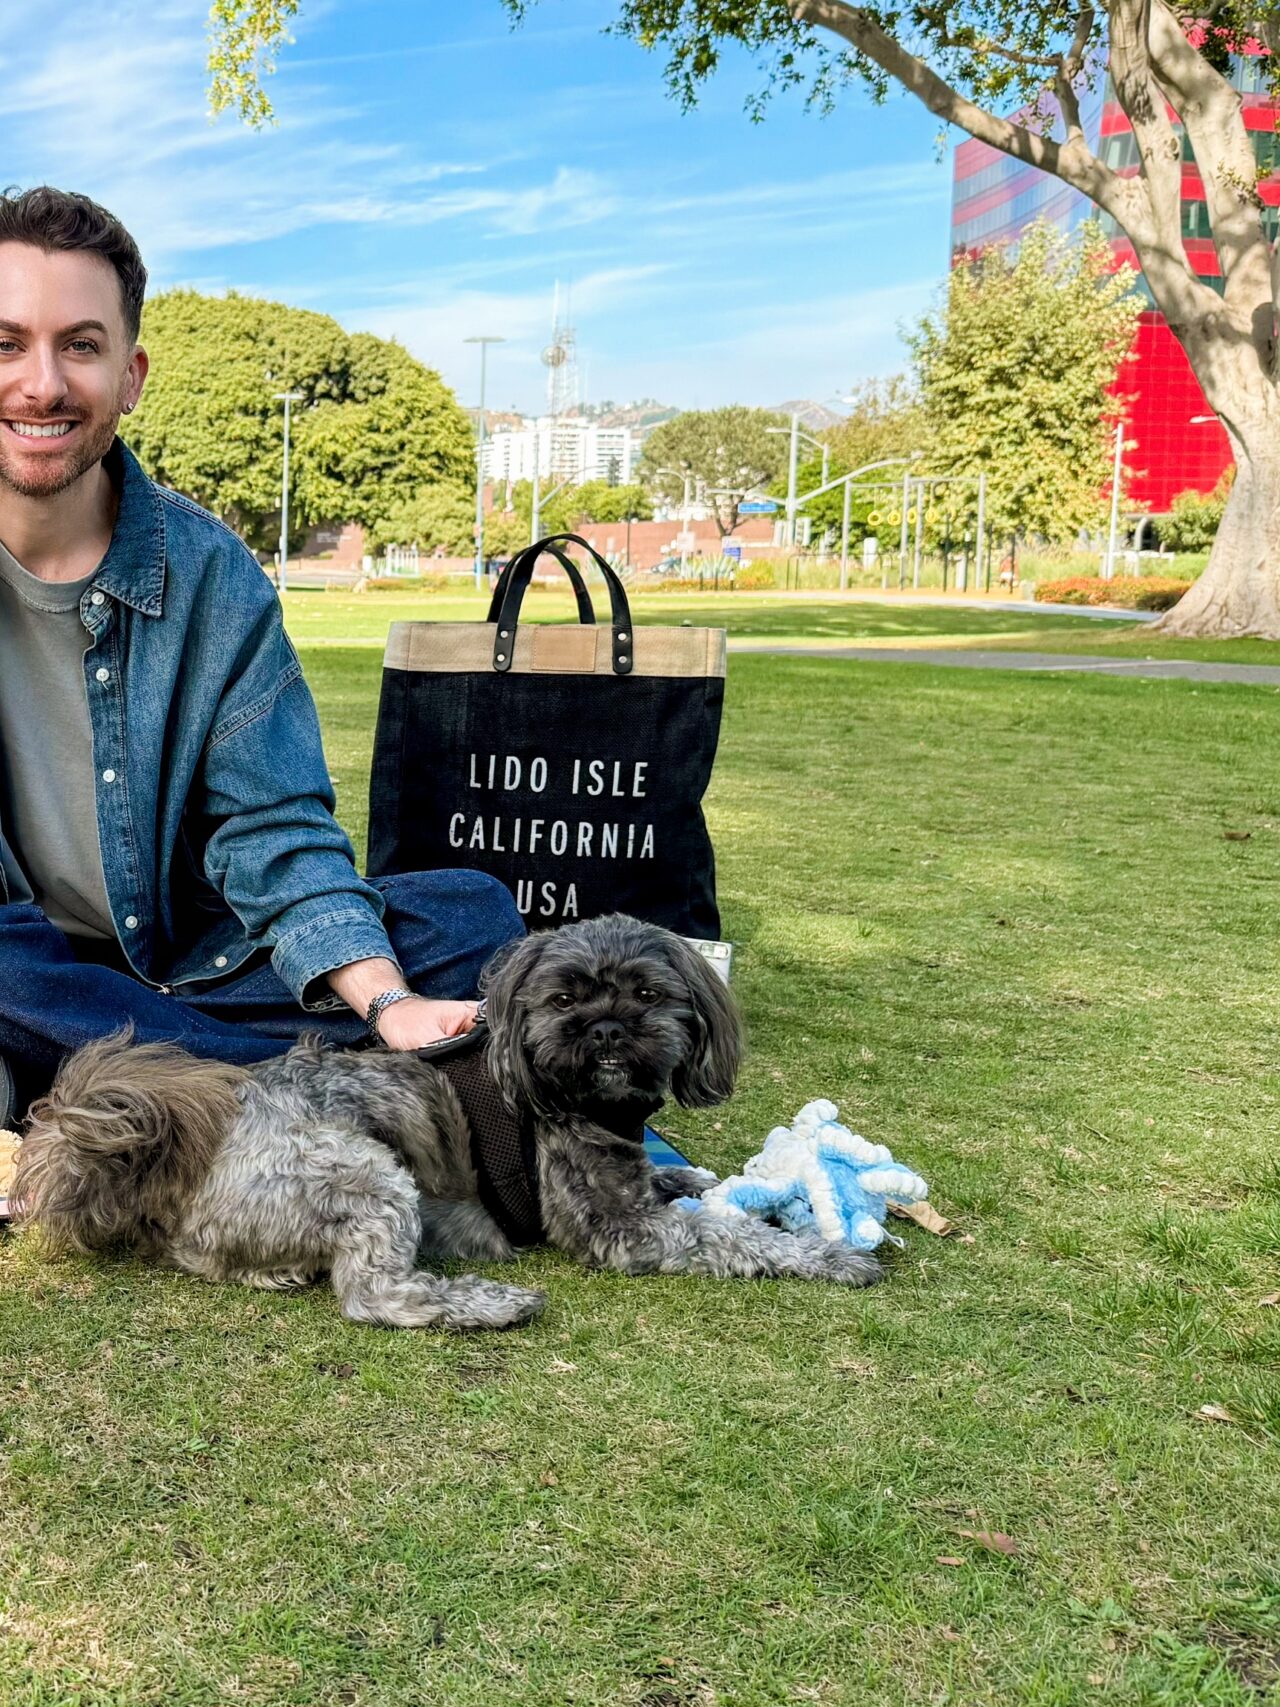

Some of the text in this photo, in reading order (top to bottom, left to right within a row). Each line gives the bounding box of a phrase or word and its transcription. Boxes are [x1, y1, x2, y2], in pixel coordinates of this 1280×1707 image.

[470, 754, 648, 797] LIDO ISLE
[449, 812, 654, 859] CALIFORNIA
[516, 879, 578, 917] USA
